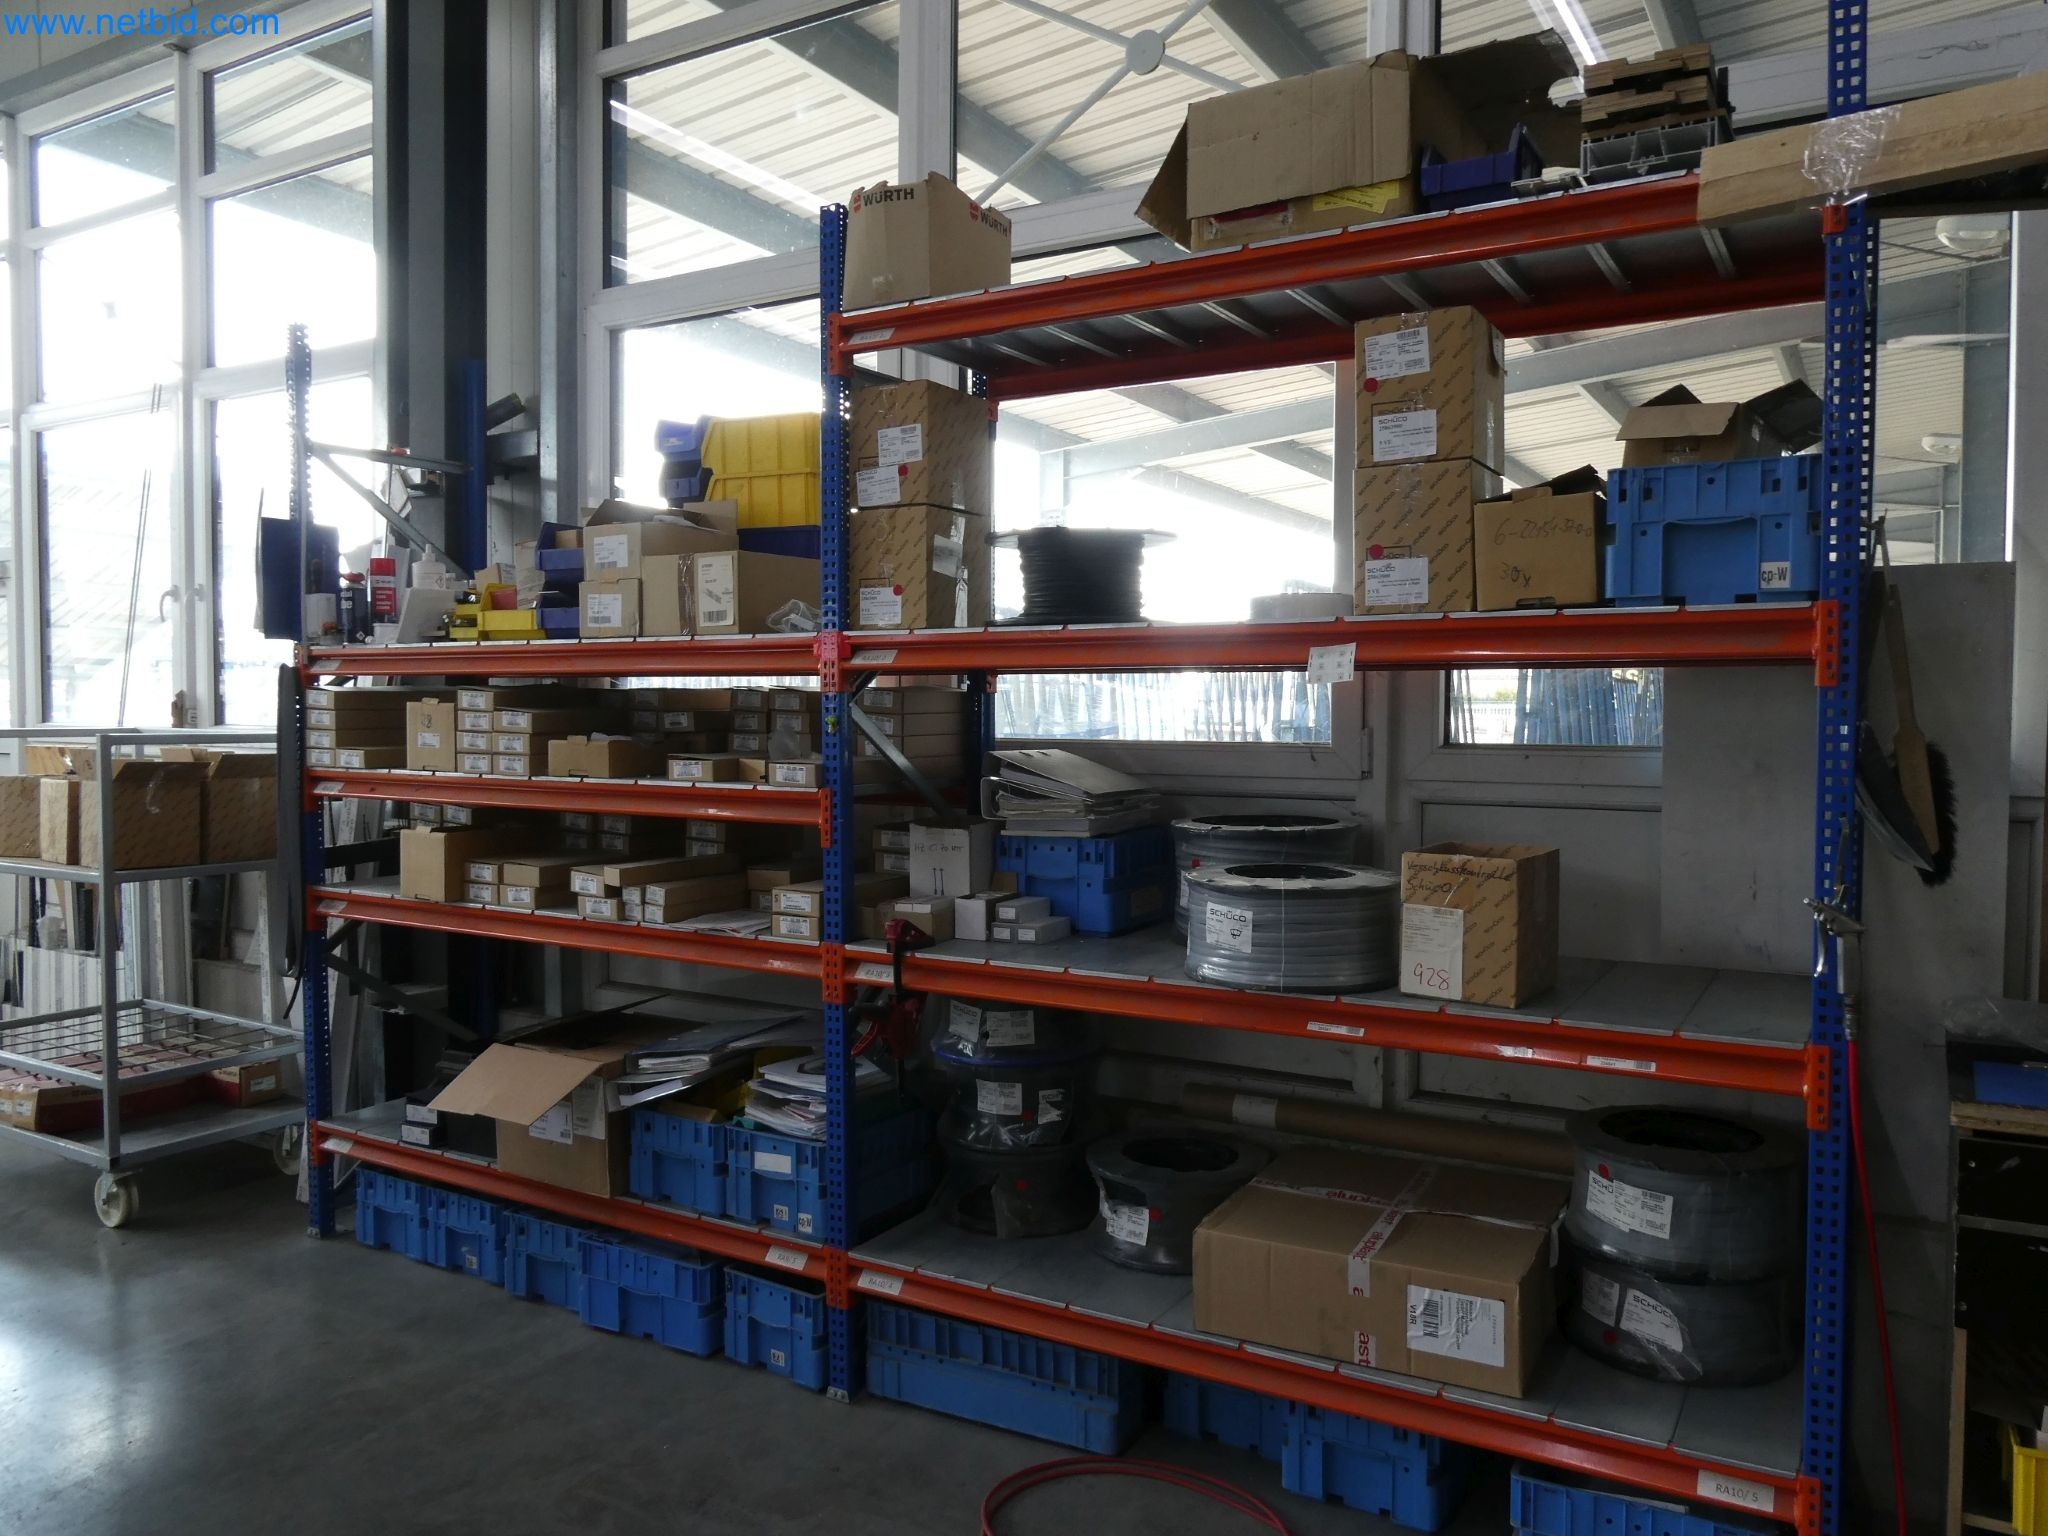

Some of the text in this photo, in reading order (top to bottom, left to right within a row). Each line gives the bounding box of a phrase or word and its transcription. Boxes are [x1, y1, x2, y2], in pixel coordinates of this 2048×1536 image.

[863, 188, 915, 207] WÜRTH
[980, 212, 1008, 237] WÜRTH
[1378, 415, 1408, 425] SCHÜCO
[1209, 907, 1247, 923] SCHÜCO
[1413, 962, 1449, 991] 928
